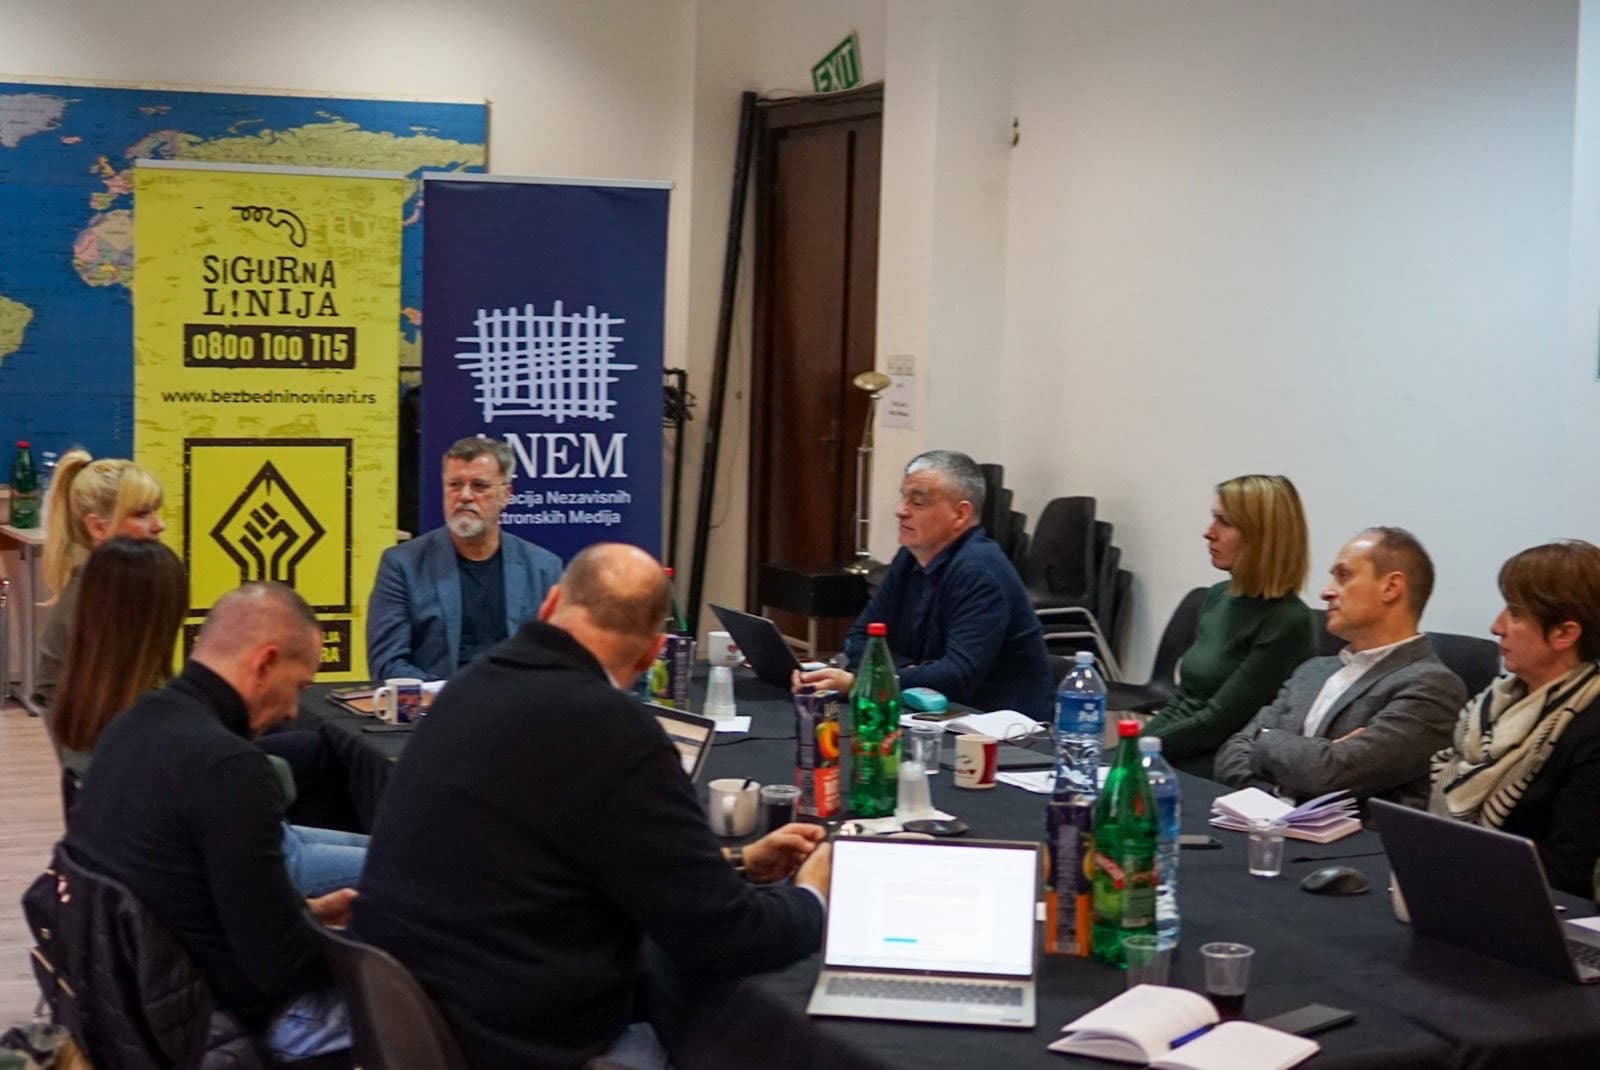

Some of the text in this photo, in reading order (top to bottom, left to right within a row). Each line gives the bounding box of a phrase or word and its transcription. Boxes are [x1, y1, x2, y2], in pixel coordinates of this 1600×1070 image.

[816, 43, 854, 93] EXIT
[192, 331, 348, 361] 0800 100 115
[161, 389, 376, 404] www.bezbedninovinari.rs
[476, 433, 628, 478] NEM
[508, 490, 632, 507] acija Nezavisnih
[569, 510, 621, 526] Medija
[320, 647, 341, 662] RA
